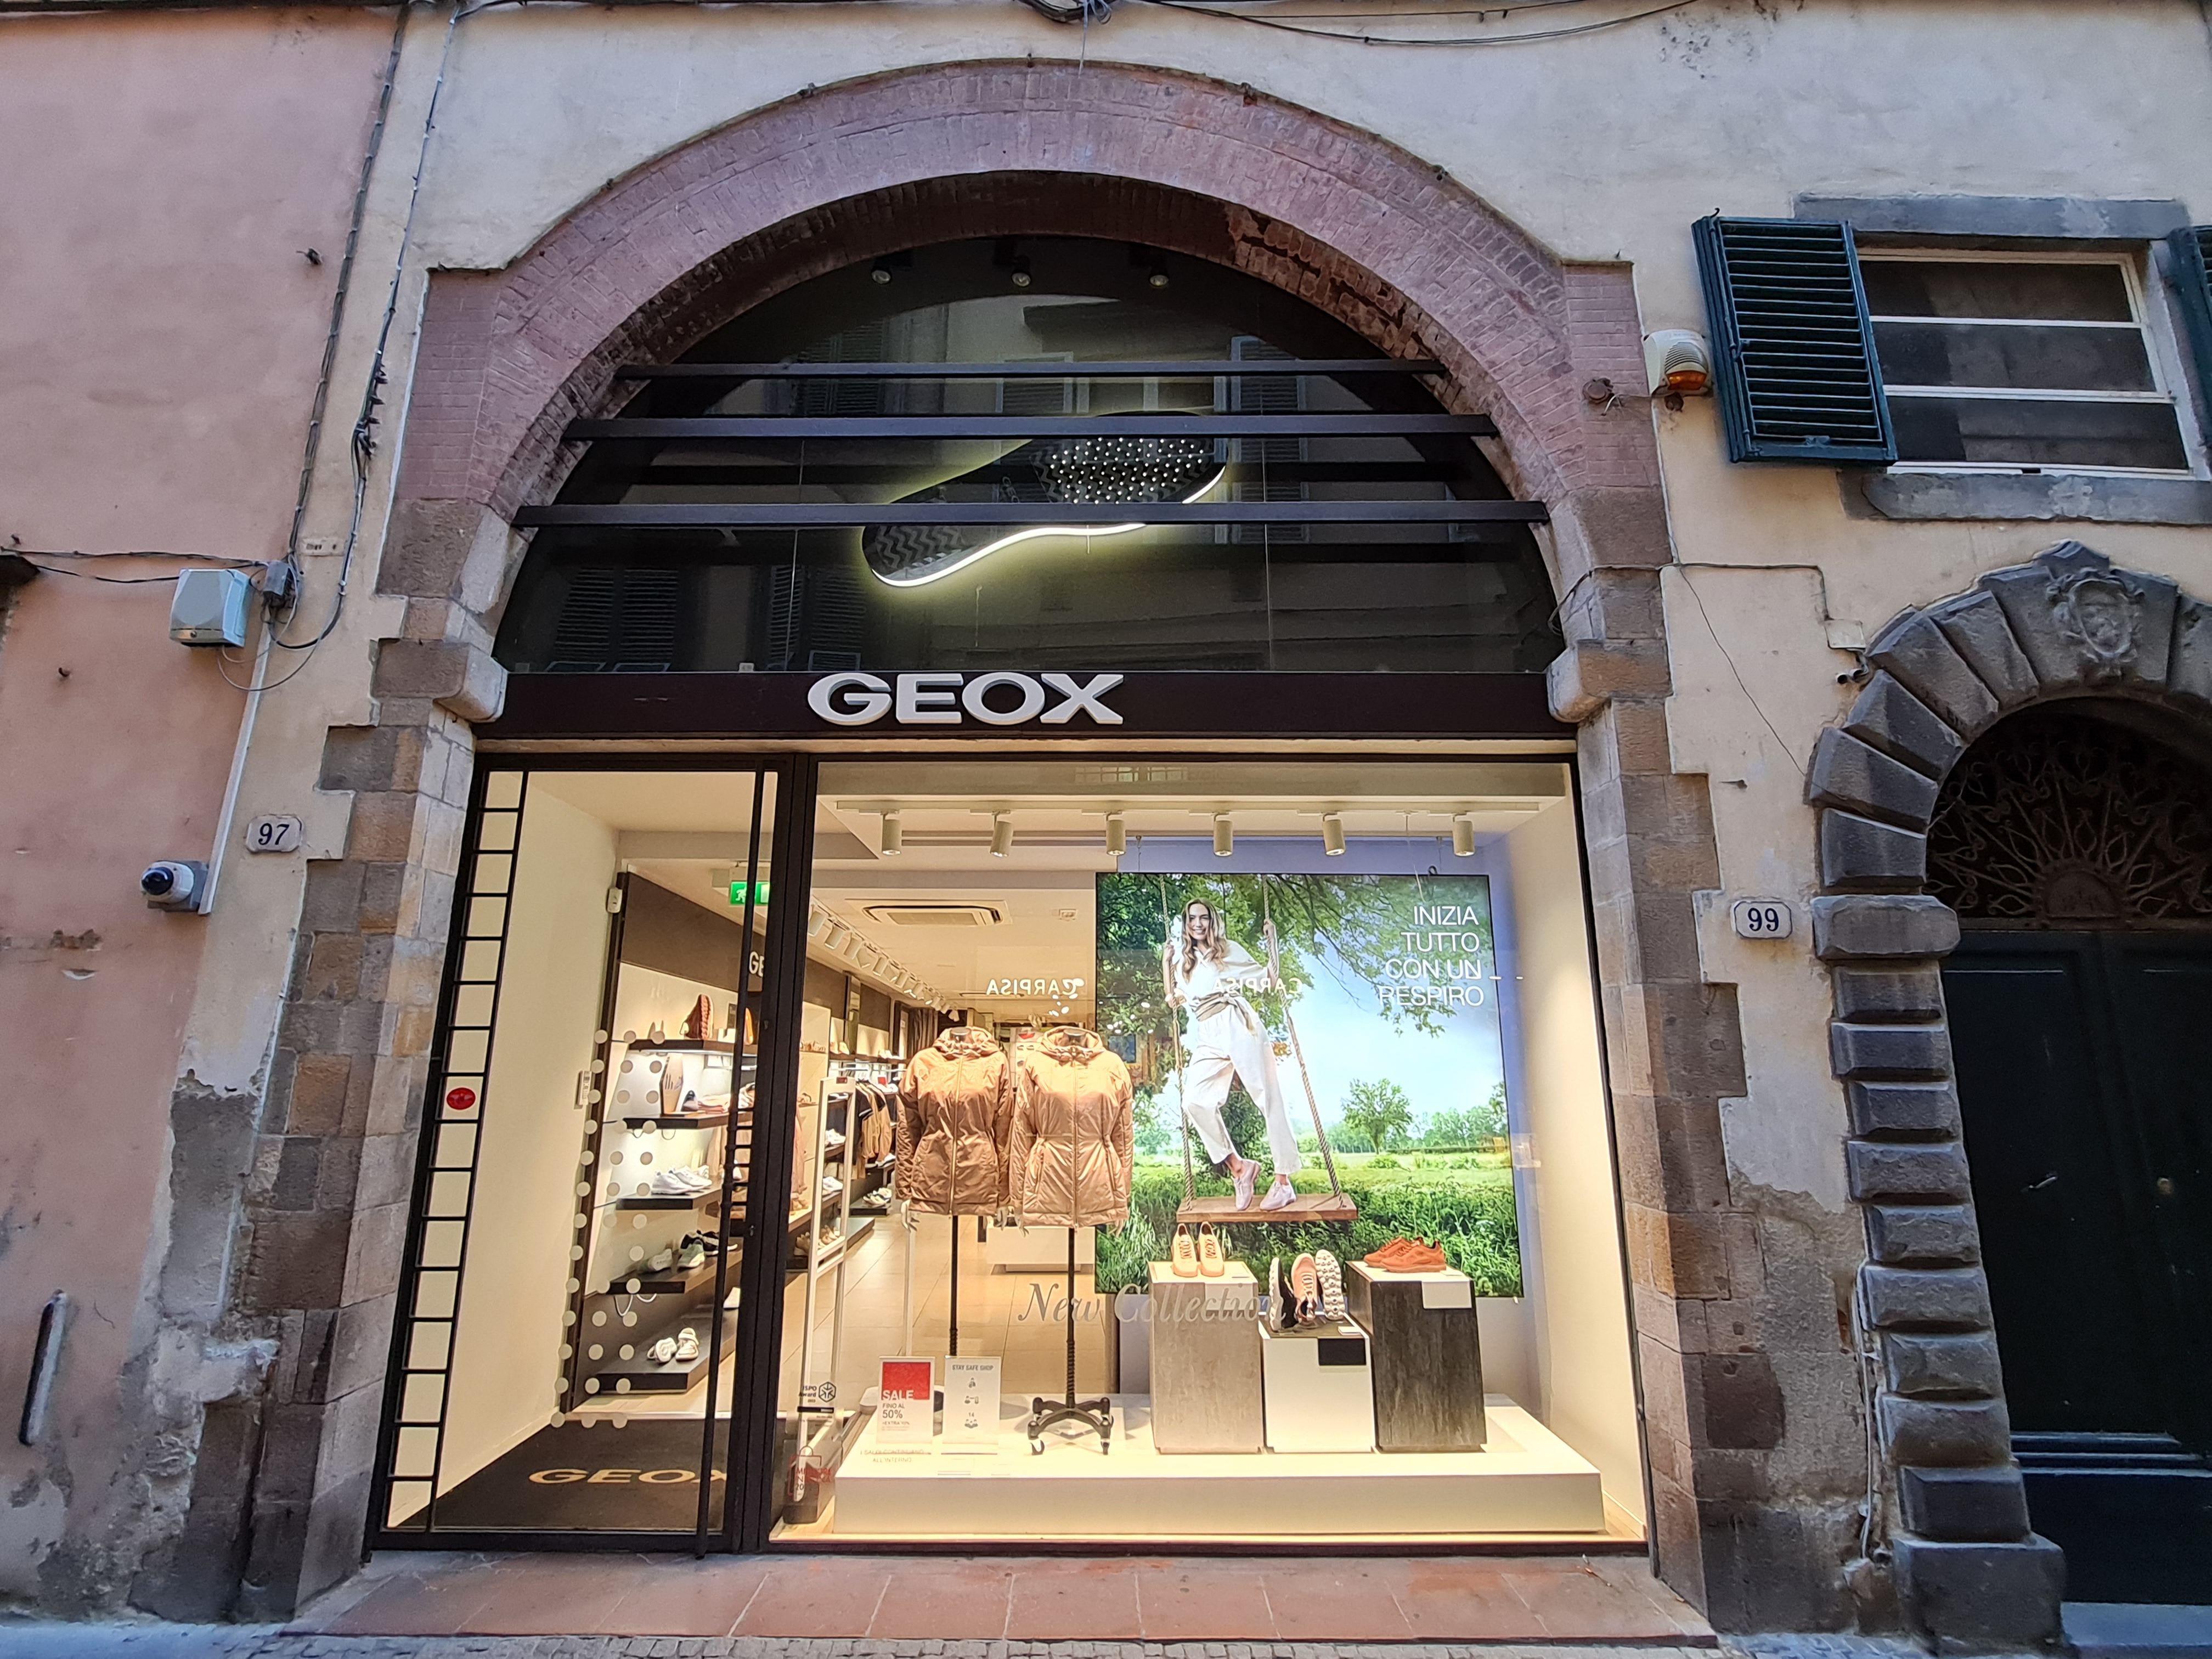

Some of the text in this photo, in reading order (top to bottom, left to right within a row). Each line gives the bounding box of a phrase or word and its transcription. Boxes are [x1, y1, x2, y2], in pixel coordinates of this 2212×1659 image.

[808, 672, 1124, 726] GEOX
[258, 822, 290, 845] 97
[1414, 906, 1479, 925] INIZIA
[1747, 907, 1779, 932] 99
[1401, 932, 1480, 952] TUTTO
[749, 951, 764, 977] GE
[1385, 958, 1481, 979] CON UN
[1379, 986, 1484, 1006] RESPIRO
[1018, 1283, 1285, 1323] New Collection
[882, 1390, 914, 1400] SALE
[882, 1409, 903, 1419] 50%
